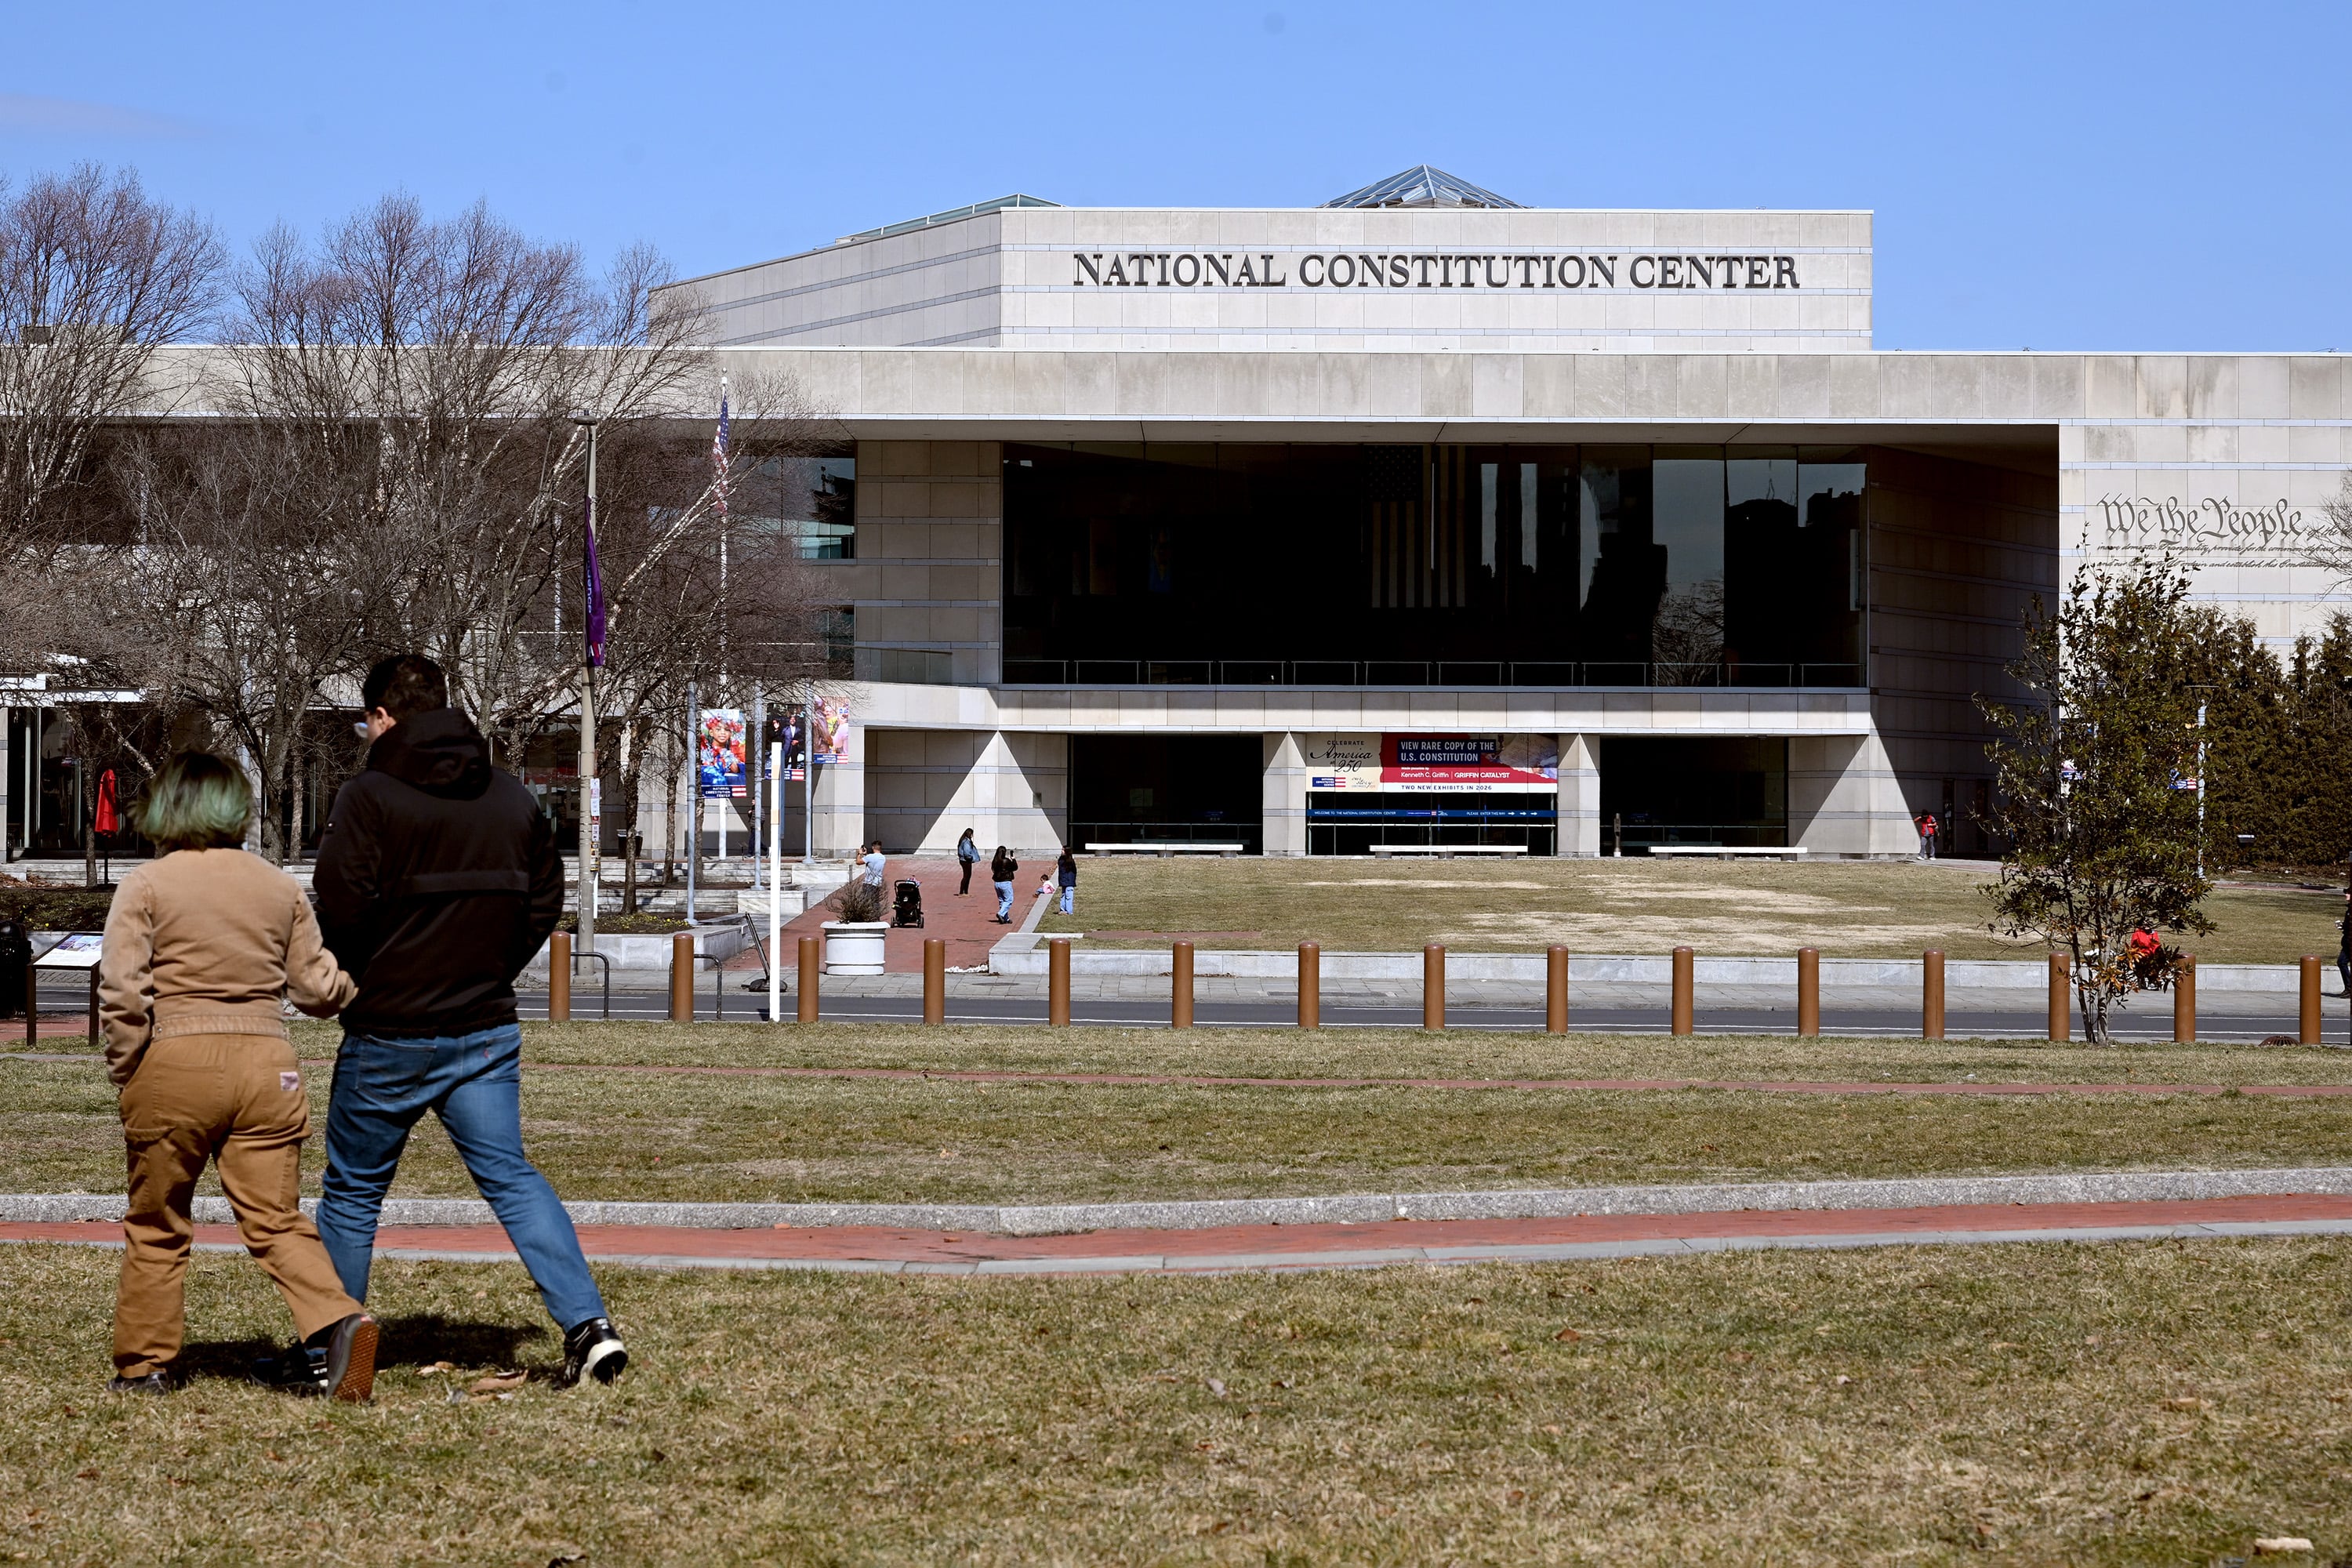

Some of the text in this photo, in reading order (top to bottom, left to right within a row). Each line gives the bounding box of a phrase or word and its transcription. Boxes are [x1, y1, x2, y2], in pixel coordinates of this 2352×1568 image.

[1073, 254, 1800, 289] NATIONAL CONSTITUTION CENTER
[2096, 492, 2157, 539] We
[2155, 496, 2206, 544] the
[2197, 495, 2308, 548] People
[1310, 744, 1373, 759] America
[1401, 741, 1494, 750] VIEW RARE COPY OF THE
[1401, 753, 1479, 761] U.S. CONSTITUTION
[1334, 760, 1362, 773] 250
